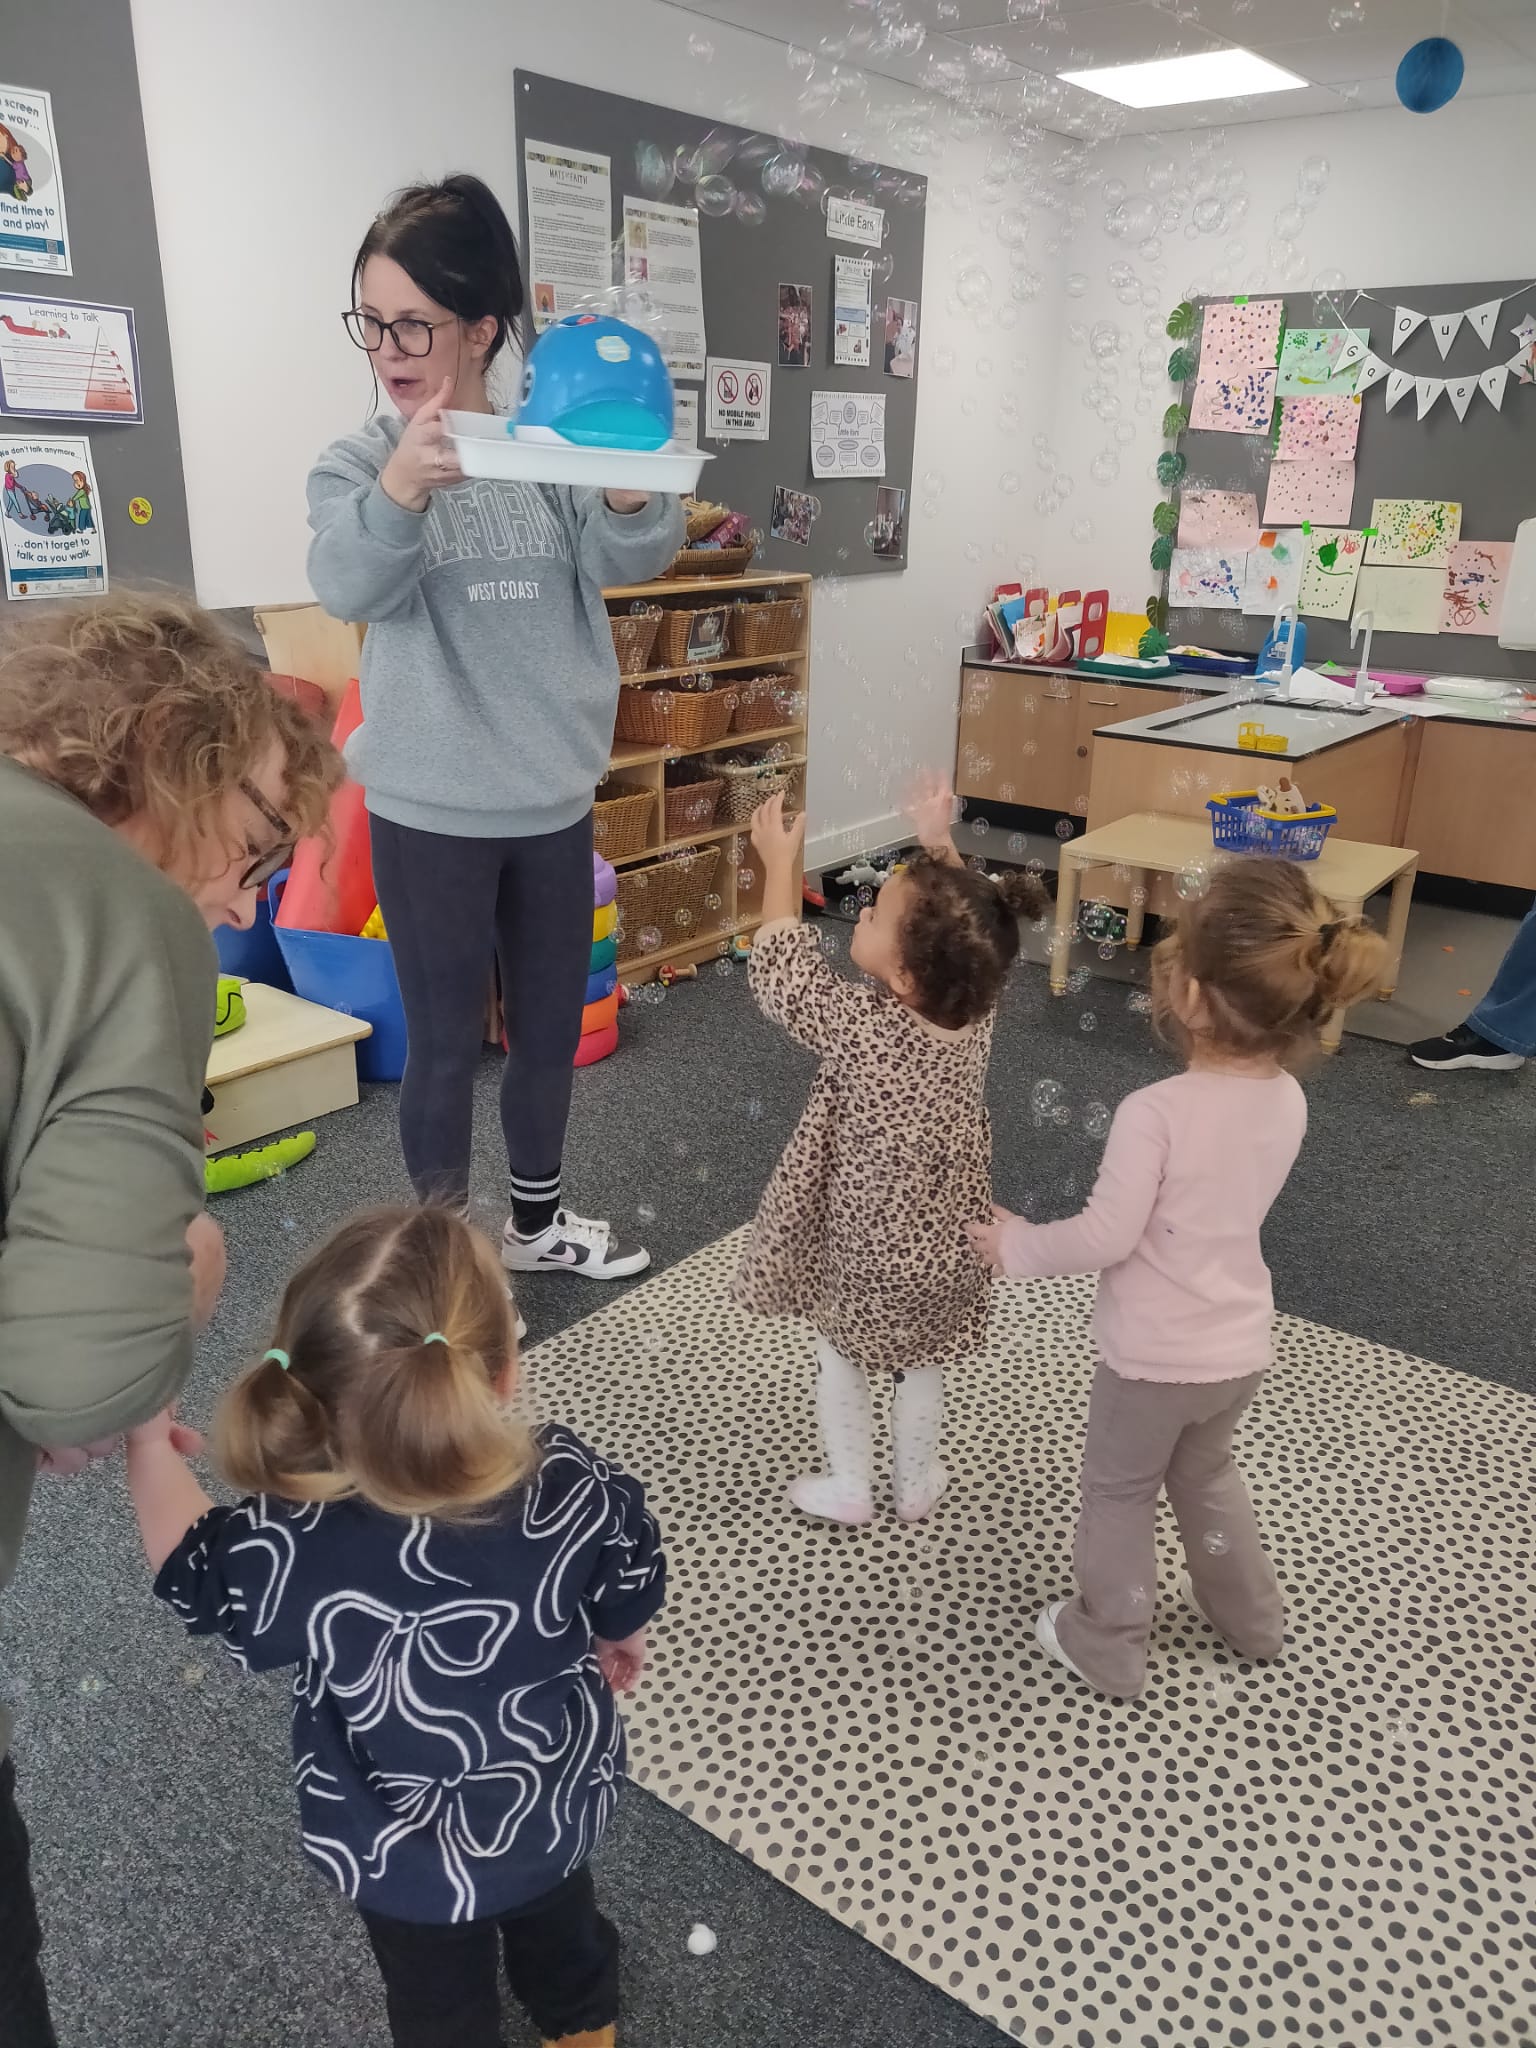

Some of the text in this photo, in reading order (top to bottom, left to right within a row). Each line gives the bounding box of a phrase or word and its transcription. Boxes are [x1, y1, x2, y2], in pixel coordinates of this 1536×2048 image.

[4, 98, 39, 117] screen
[0, 202, 55, 216] find time to
[3, 219, 49, 231] and play!
[835, 209, 874, 231] Little Ears
[28, 306, 99, 322] Learning to Talk
[1399, 313, 1488, 336] Our
[745, 410, 761, 419] PHONES
[732, 418, 742, 426] THIS
[744, 419, 755, 427] AREA
[11, 446, 28, 454] don't
[30, 445, 42, 453] talk
[51, 539, 78, 550] forget
[80, 538, 90, 546] to
[17, 550, 34, 561] talk
[50, 554, 67, 563] you
[69, 549, 90, 560] walk
[467, 580, 540, 602] WEST COAST
